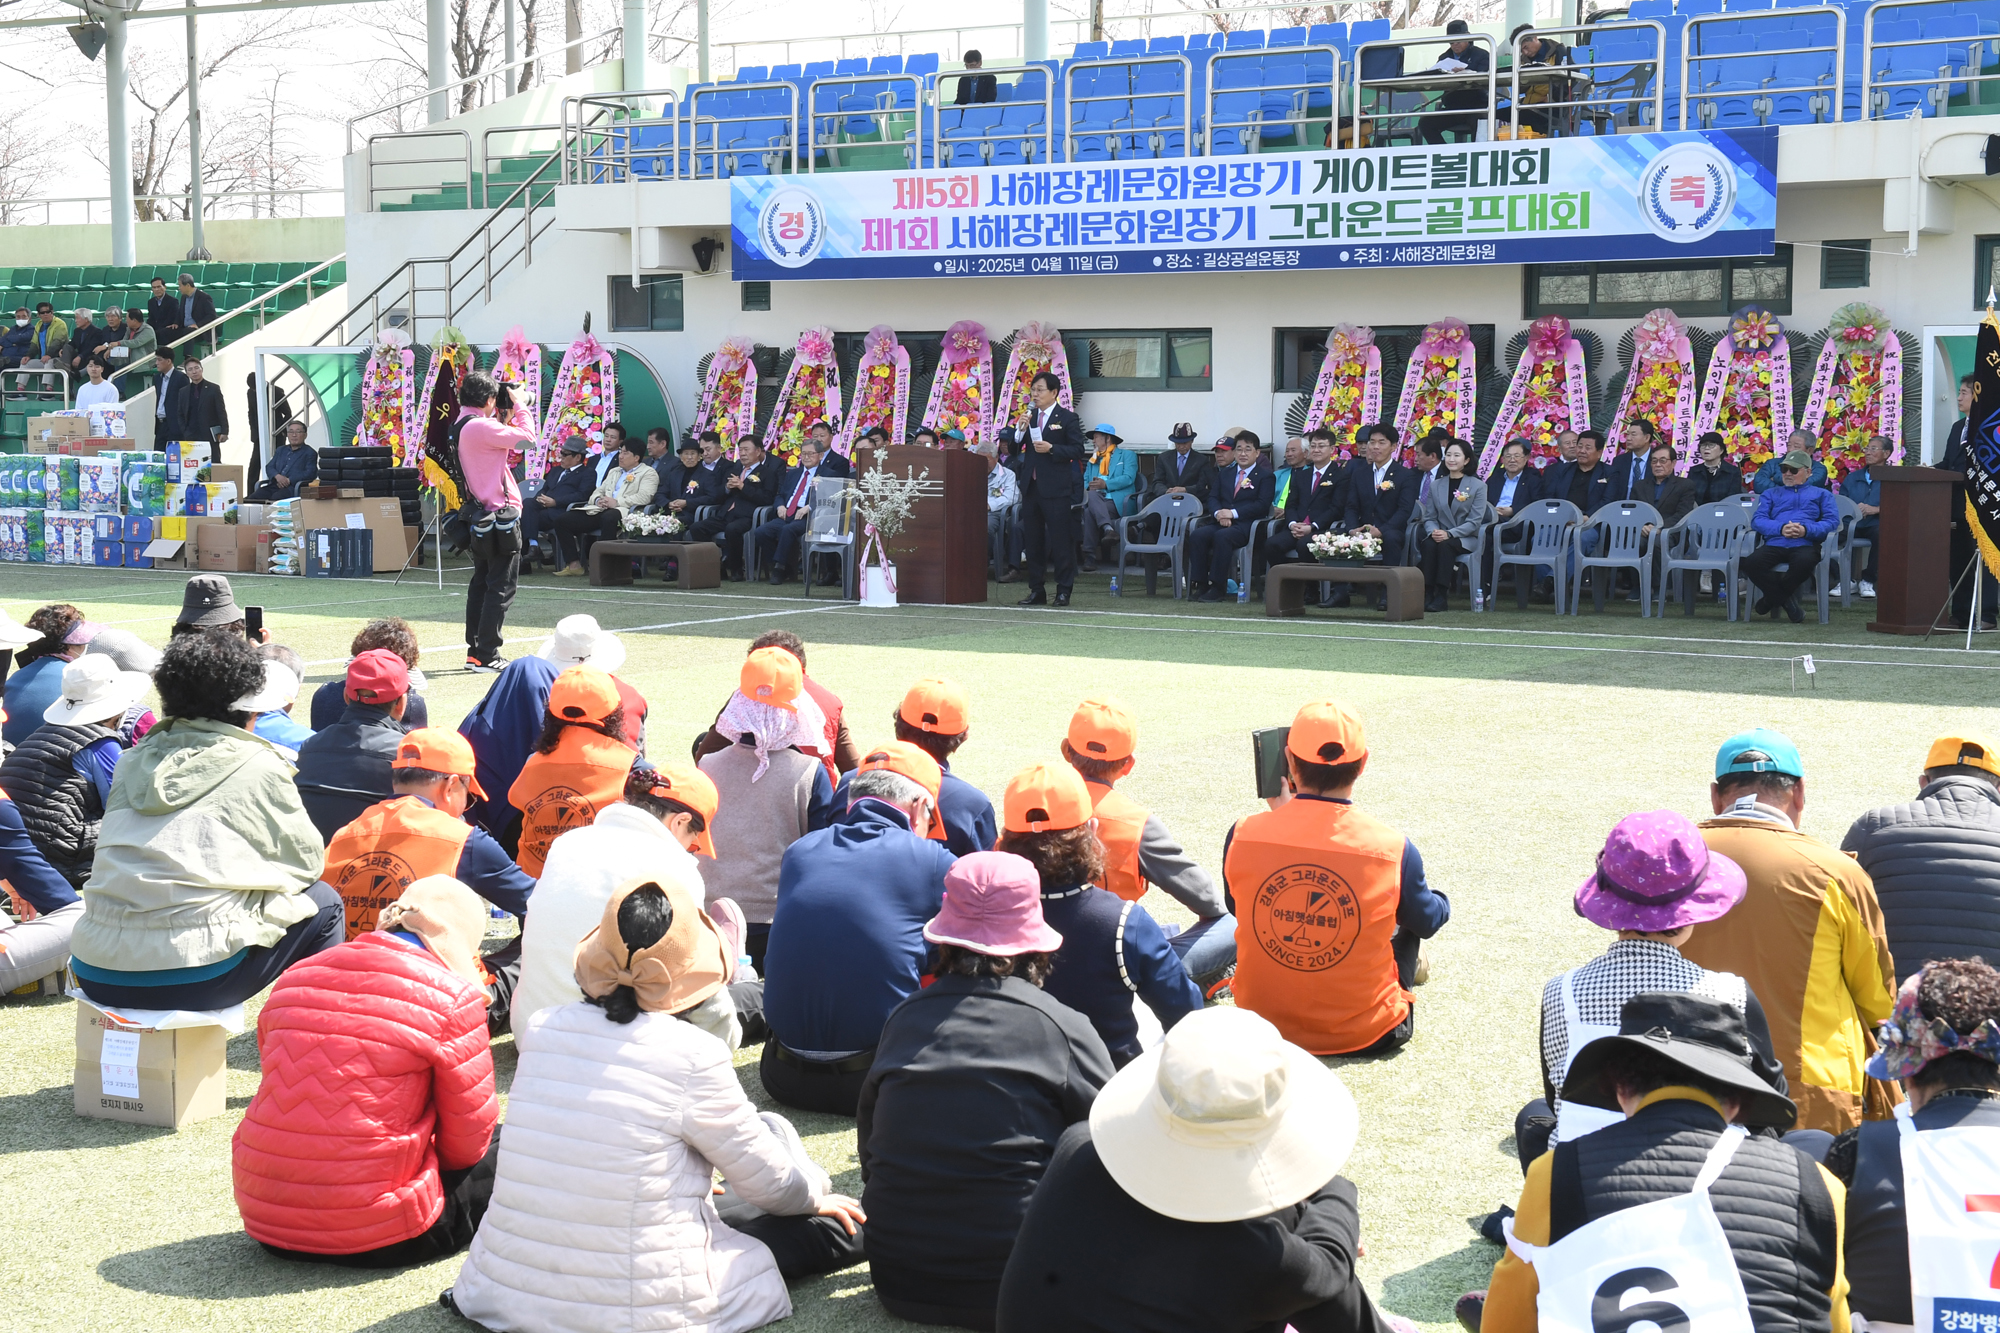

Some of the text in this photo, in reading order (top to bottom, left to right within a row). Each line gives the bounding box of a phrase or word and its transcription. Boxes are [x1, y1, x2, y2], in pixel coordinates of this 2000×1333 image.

[892, 147, 1550, 211] 제5회 서해장례문화원장기 게이트볼대회
[1670, 176, 1706, 209] 축
[779, 212, 806, 240] 경
[860, 191, 1592, 252] 제1회 서해장례문화원장기 그라운드골프대회
[978, 256, 1025, 274] 2025년
[1031, 256, 1063, 272] 04월
[1203, 250, 1300, 268] 길상공설운동장
[1392, 244, 1496, 263] 서해장례문화원
[1458, 367, 1473, 430] 교동향교
[360, 856, 402, 875] 그라운드
[1259, 870, 1355, 919] 강화군 그라운드 골프
[1273, 909, 1338, 929] 아침햇살클럽
[1265, 938, 1342, 968] SINCE 2024
[123, 1102, 144, 1112] 마시오
